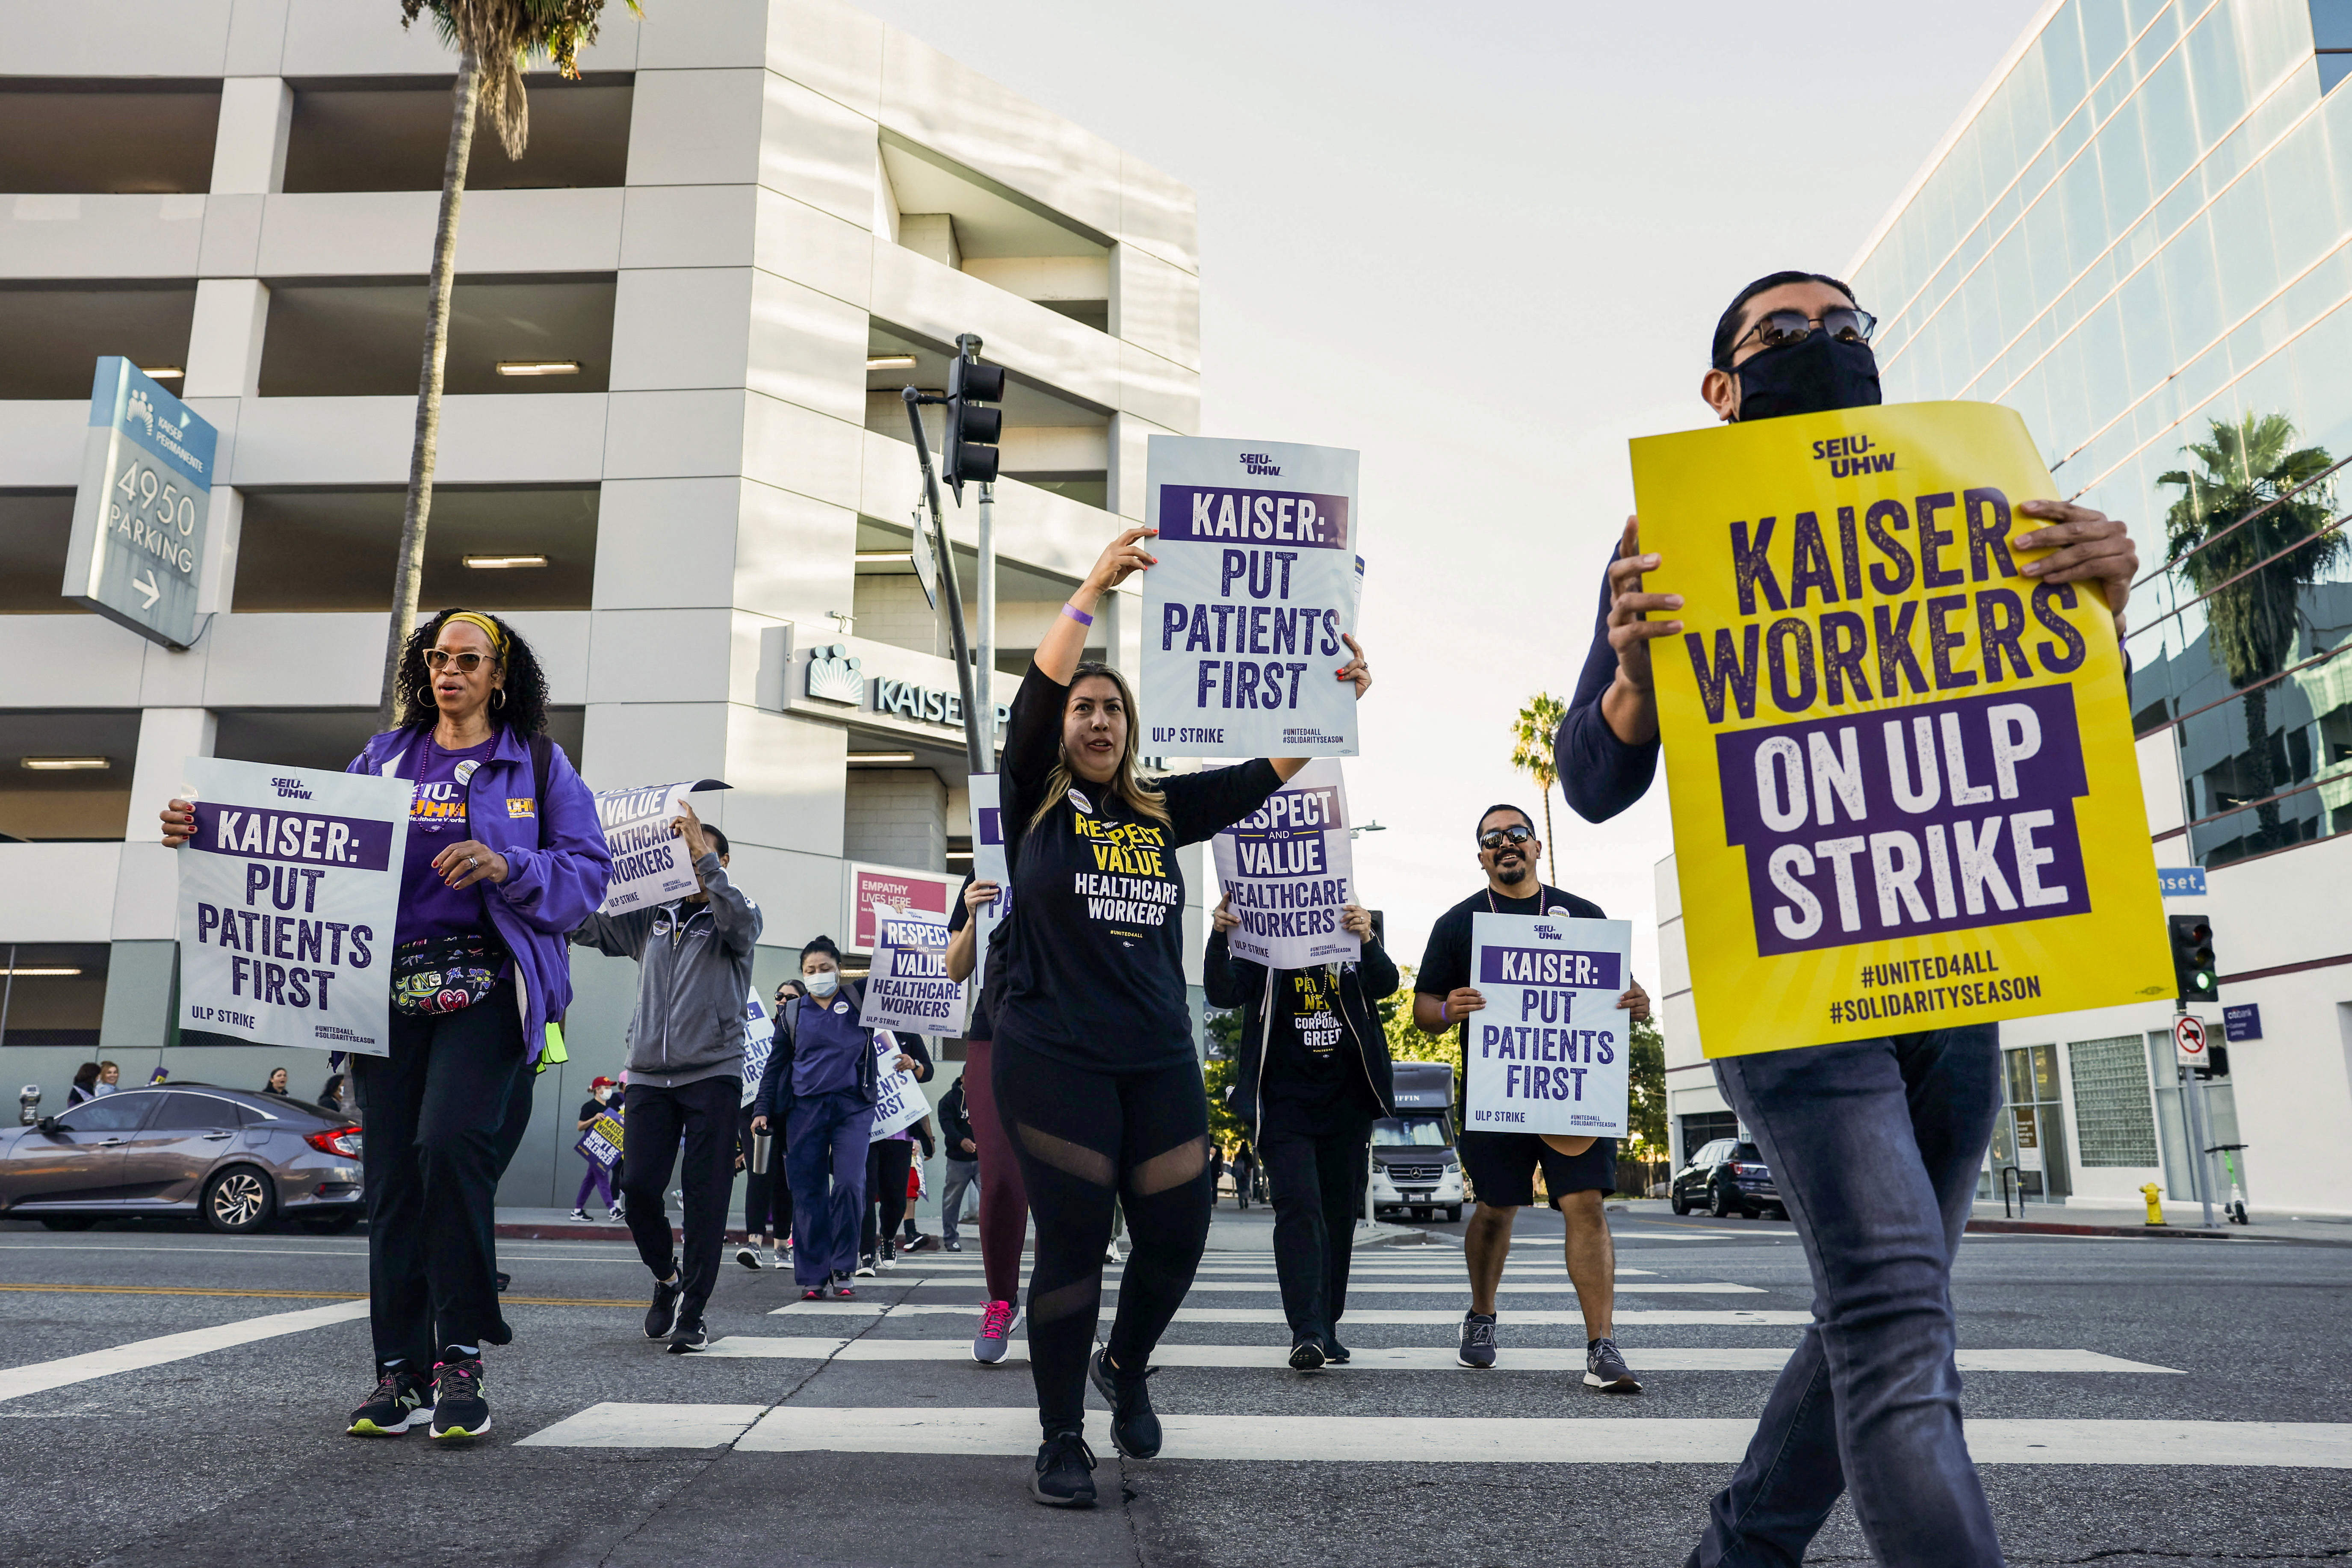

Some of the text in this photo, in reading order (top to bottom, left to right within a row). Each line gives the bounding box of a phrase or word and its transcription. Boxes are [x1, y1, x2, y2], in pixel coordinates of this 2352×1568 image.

[158, 416, 183, 441] KAISER
[157, 431, 203, 474] PERMANENTE
[1240, 453, 1272, 464] SEIU-
[1813, 434, 1876, 460] SEIU-
[1247, 464, 1281, 476] UHW
[1830, 452, 1896, 478] UHW
[118, 458, 195, 537] 4950
[1192, 493, 1325, 542] KAISER:
[109, 504, 192, 573] PARKING
[1729, 487, 2018, 616] KAISER
[1221, 549, 1297, 599] PUT
[1163, 603, 1340, 656] PATIENTS
[1685, 582, 2087, 724] WORKERS
[1198, 660, 1307, 709] FIRST
[875, 676, 966, 726] KAISE
[1152, 727, 1224, 743] ULP STRIKE
[271, 777, 304, 788] SEIU-
[1754, 703, 2042, 833] ON ULP
[278, 788, 313, 800] UHW
[606, 789, 666, 827] VALUE
[1226, 791, 1331, 829] SPECT
[218, 810, 360, 863] KAISER:
[1076, 812, 1165, 847] REPECT
[1269, 830, 1289, 839] AND
[1121, 840, 1137, 852] nd
[1239, 839, 1321, 874] VALUE
[1093, 845, 1166, 877] VALUE
[1768, 809, 2069, 941] STRIKE
[246, 863, 325, 913] PUT
[609, 892, 639, 908] ULP STRIKE
[665, 881, 692, 892] #SOLIDARITYSEASON
[862, 880, 908, 895] EMPATHY
[862, 892, 886, 904] LIVES
[1075, 873, 1177, 905] HEALTHCARE
[1225, 878, 1348, 909] HEALTHCARE
[1088, 897, 1166, 926] WORKERS
[1238, 908, 1335, 938] WORKERS
[198, 902, 373, 969] PATIENTS
[887, 922, 951, 946] RESPECT
[1110, 930, 1143, 938] #UNITED4ALL
[1310, 943, 1336, 952] #UNITED4ALL
[1235, 940, 1269, 958] ULP STRIKE
[1310, 947, 1351, 957] #SOLIDARITYSEASON
[897, 954, 947, 976] VALUE
[1502, 951, 1599, 985] KAISER:
[1861, 950, 1999, 988] #UNITED4ALL
[232, 955, 335, 1010] FIRST
[872, 978, 962, 1000] HEALTHCARE
[881, 996, 950, 1018] WORKERS
[1522, 989, 1577, 1024] PUT
[1829, 975, 2042, 1024] #SOLIDARITYSEASON
[192, 1005, 255, 1030] ULP STRIKE
[315, 1025, 354, 1036] #UNITED4ALL
[879, 1018, 899, 1027] STRIKE
[1295, 1016, 1342, 1029] CORPORA
[315, 1031, 375, 1045] #SOLIDARITYSEASON
[1483, 1025, 1614, 1065] PATIENTS
[1507, 1065, 1588, 1101] FIRST
[1475, 1110, 1525, 1123] ULP STRIKE
[583, 1137, 613, 1165] SILENCED
[589, 1130, 611, 1151] WON'T
[608, 1147, 619, 1158] BE
